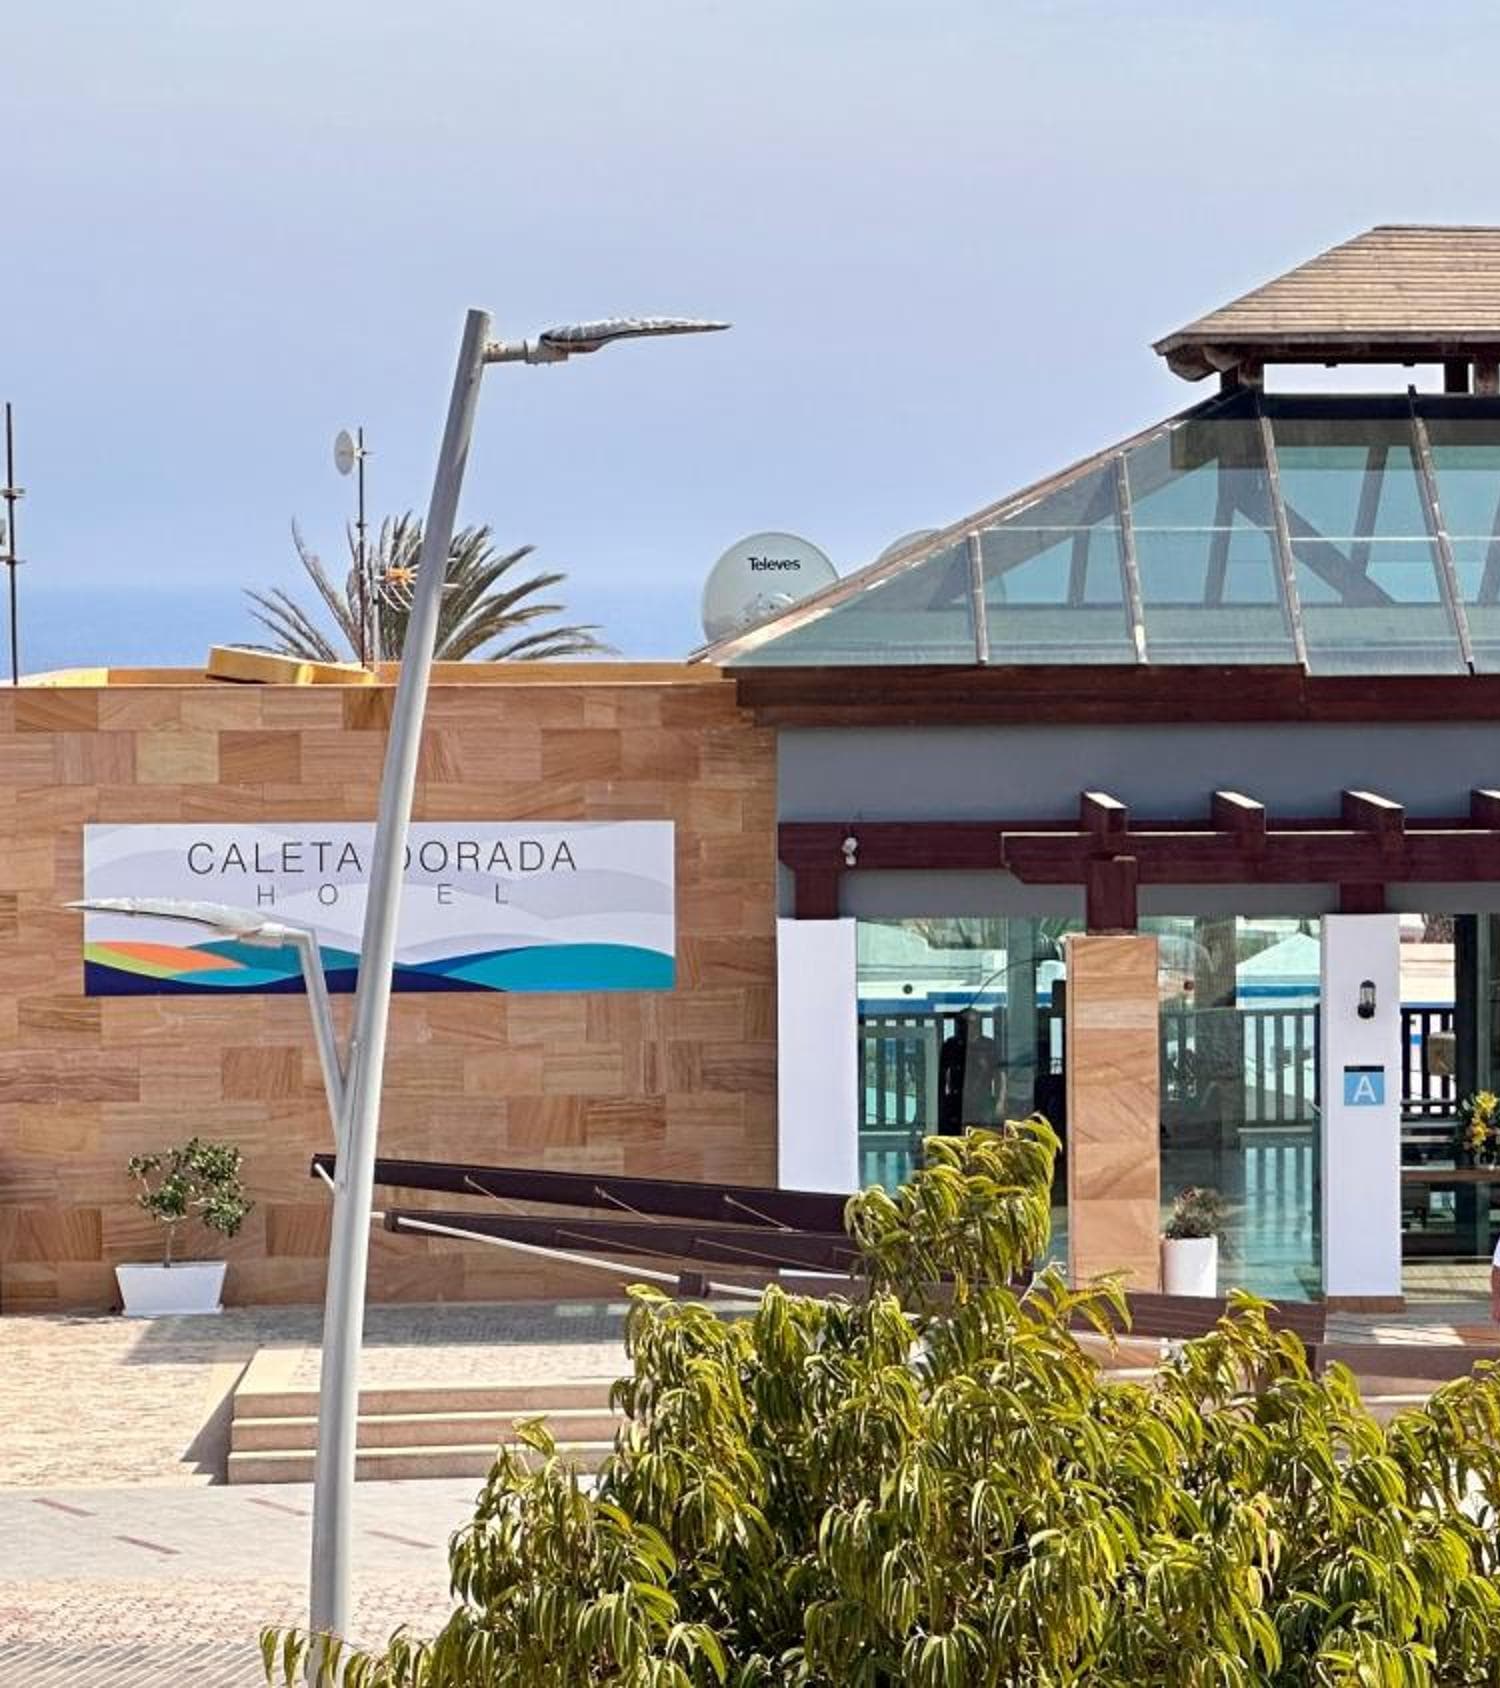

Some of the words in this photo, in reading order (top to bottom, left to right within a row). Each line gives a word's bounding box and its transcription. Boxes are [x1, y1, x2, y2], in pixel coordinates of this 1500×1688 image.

[747, 556, 801, 571] Televes
[187, 841, 363, 875] CALETA
[403, 840, 577, 873] ORADA
[257, 883, 509, 906] HOEL
[1352, 1074, 1377, 1103] A
